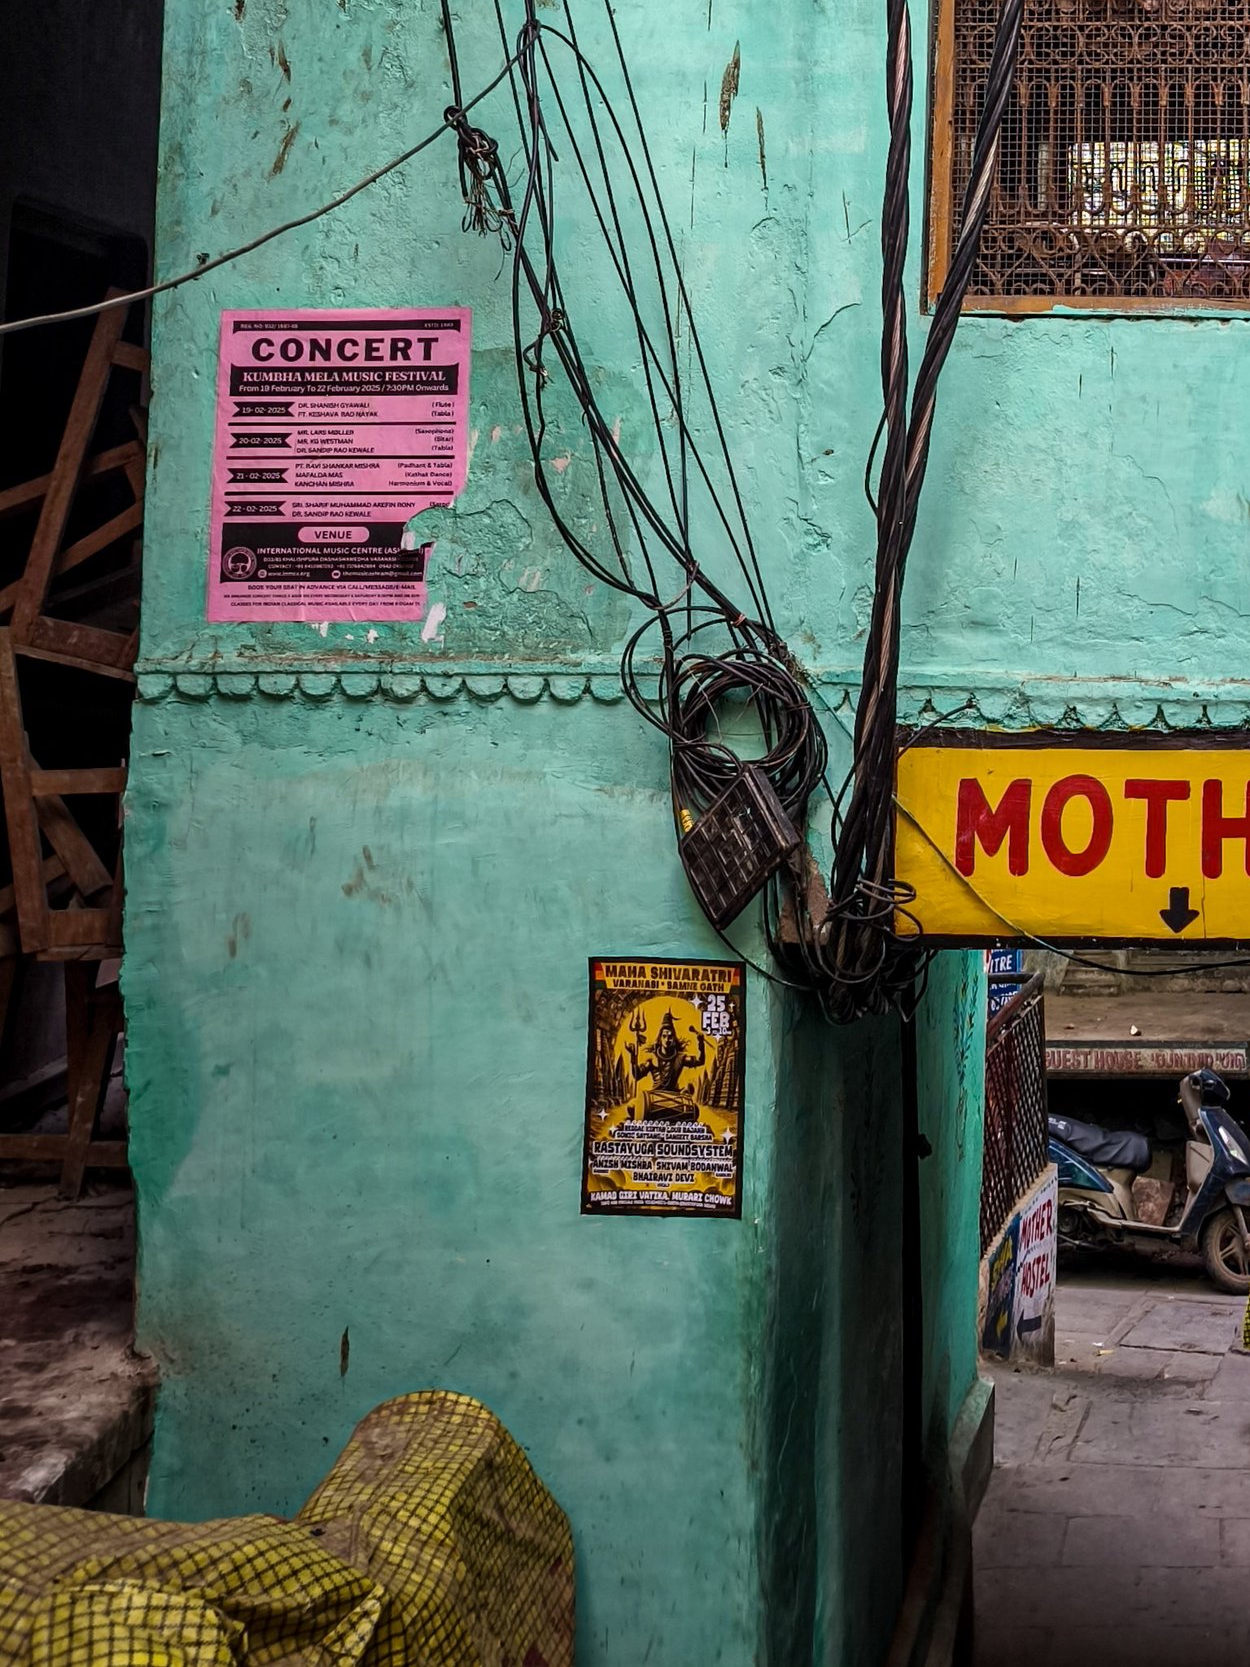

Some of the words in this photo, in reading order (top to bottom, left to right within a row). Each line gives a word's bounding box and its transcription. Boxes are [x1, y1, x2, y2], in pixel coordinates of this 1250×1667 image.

[251, 337, 439, 362] CONCERT
[243, 371, 302, 382] KUMBHA
[304, 371, 340, 382] MELA
[342, 371, 383, 382] MUSIC
[385, 371, 446, 382] FESTIVAL
[239, 384, 259, 392] From
[271, 384, 305, 394] February
[307, 384, 316, 392] To
[317, 384, 326, 392] 22
[327, 384, 360, 393] February
[361, 384, 381, 392] 2025
[314, 530, 352, 539] VENUE
[605, 965, 647, 978] MAHA
[650, 966, 732, 983] SHIVARATRI
[613, 979, 659, 989] VARANASI
[707, 994, 726, 1012] 25
[702, 1011, 731, 1029] FEB
[1094, 1051, 1144, 1070] HOUSE
[657, 1143, 733, 1157] SOUNDSYSTEM
[593, 1159, 619, 1168] ANISH
[620, 1160, 653, 1170] MISHRA
[656, 1161, 688, 1171] SHIVAM
[633, 1172, 673, 1182] BHAIRAVI
[675, 1174, 695, 1182] DEVI
[671, 1192, 703, 1202] MURARI
[704, 1193, 732, 1205] CHOWK
[1021, 1199, 1053, 1250] MOTHER
[1021, 1253, 1051, 1299] HOSTEL
